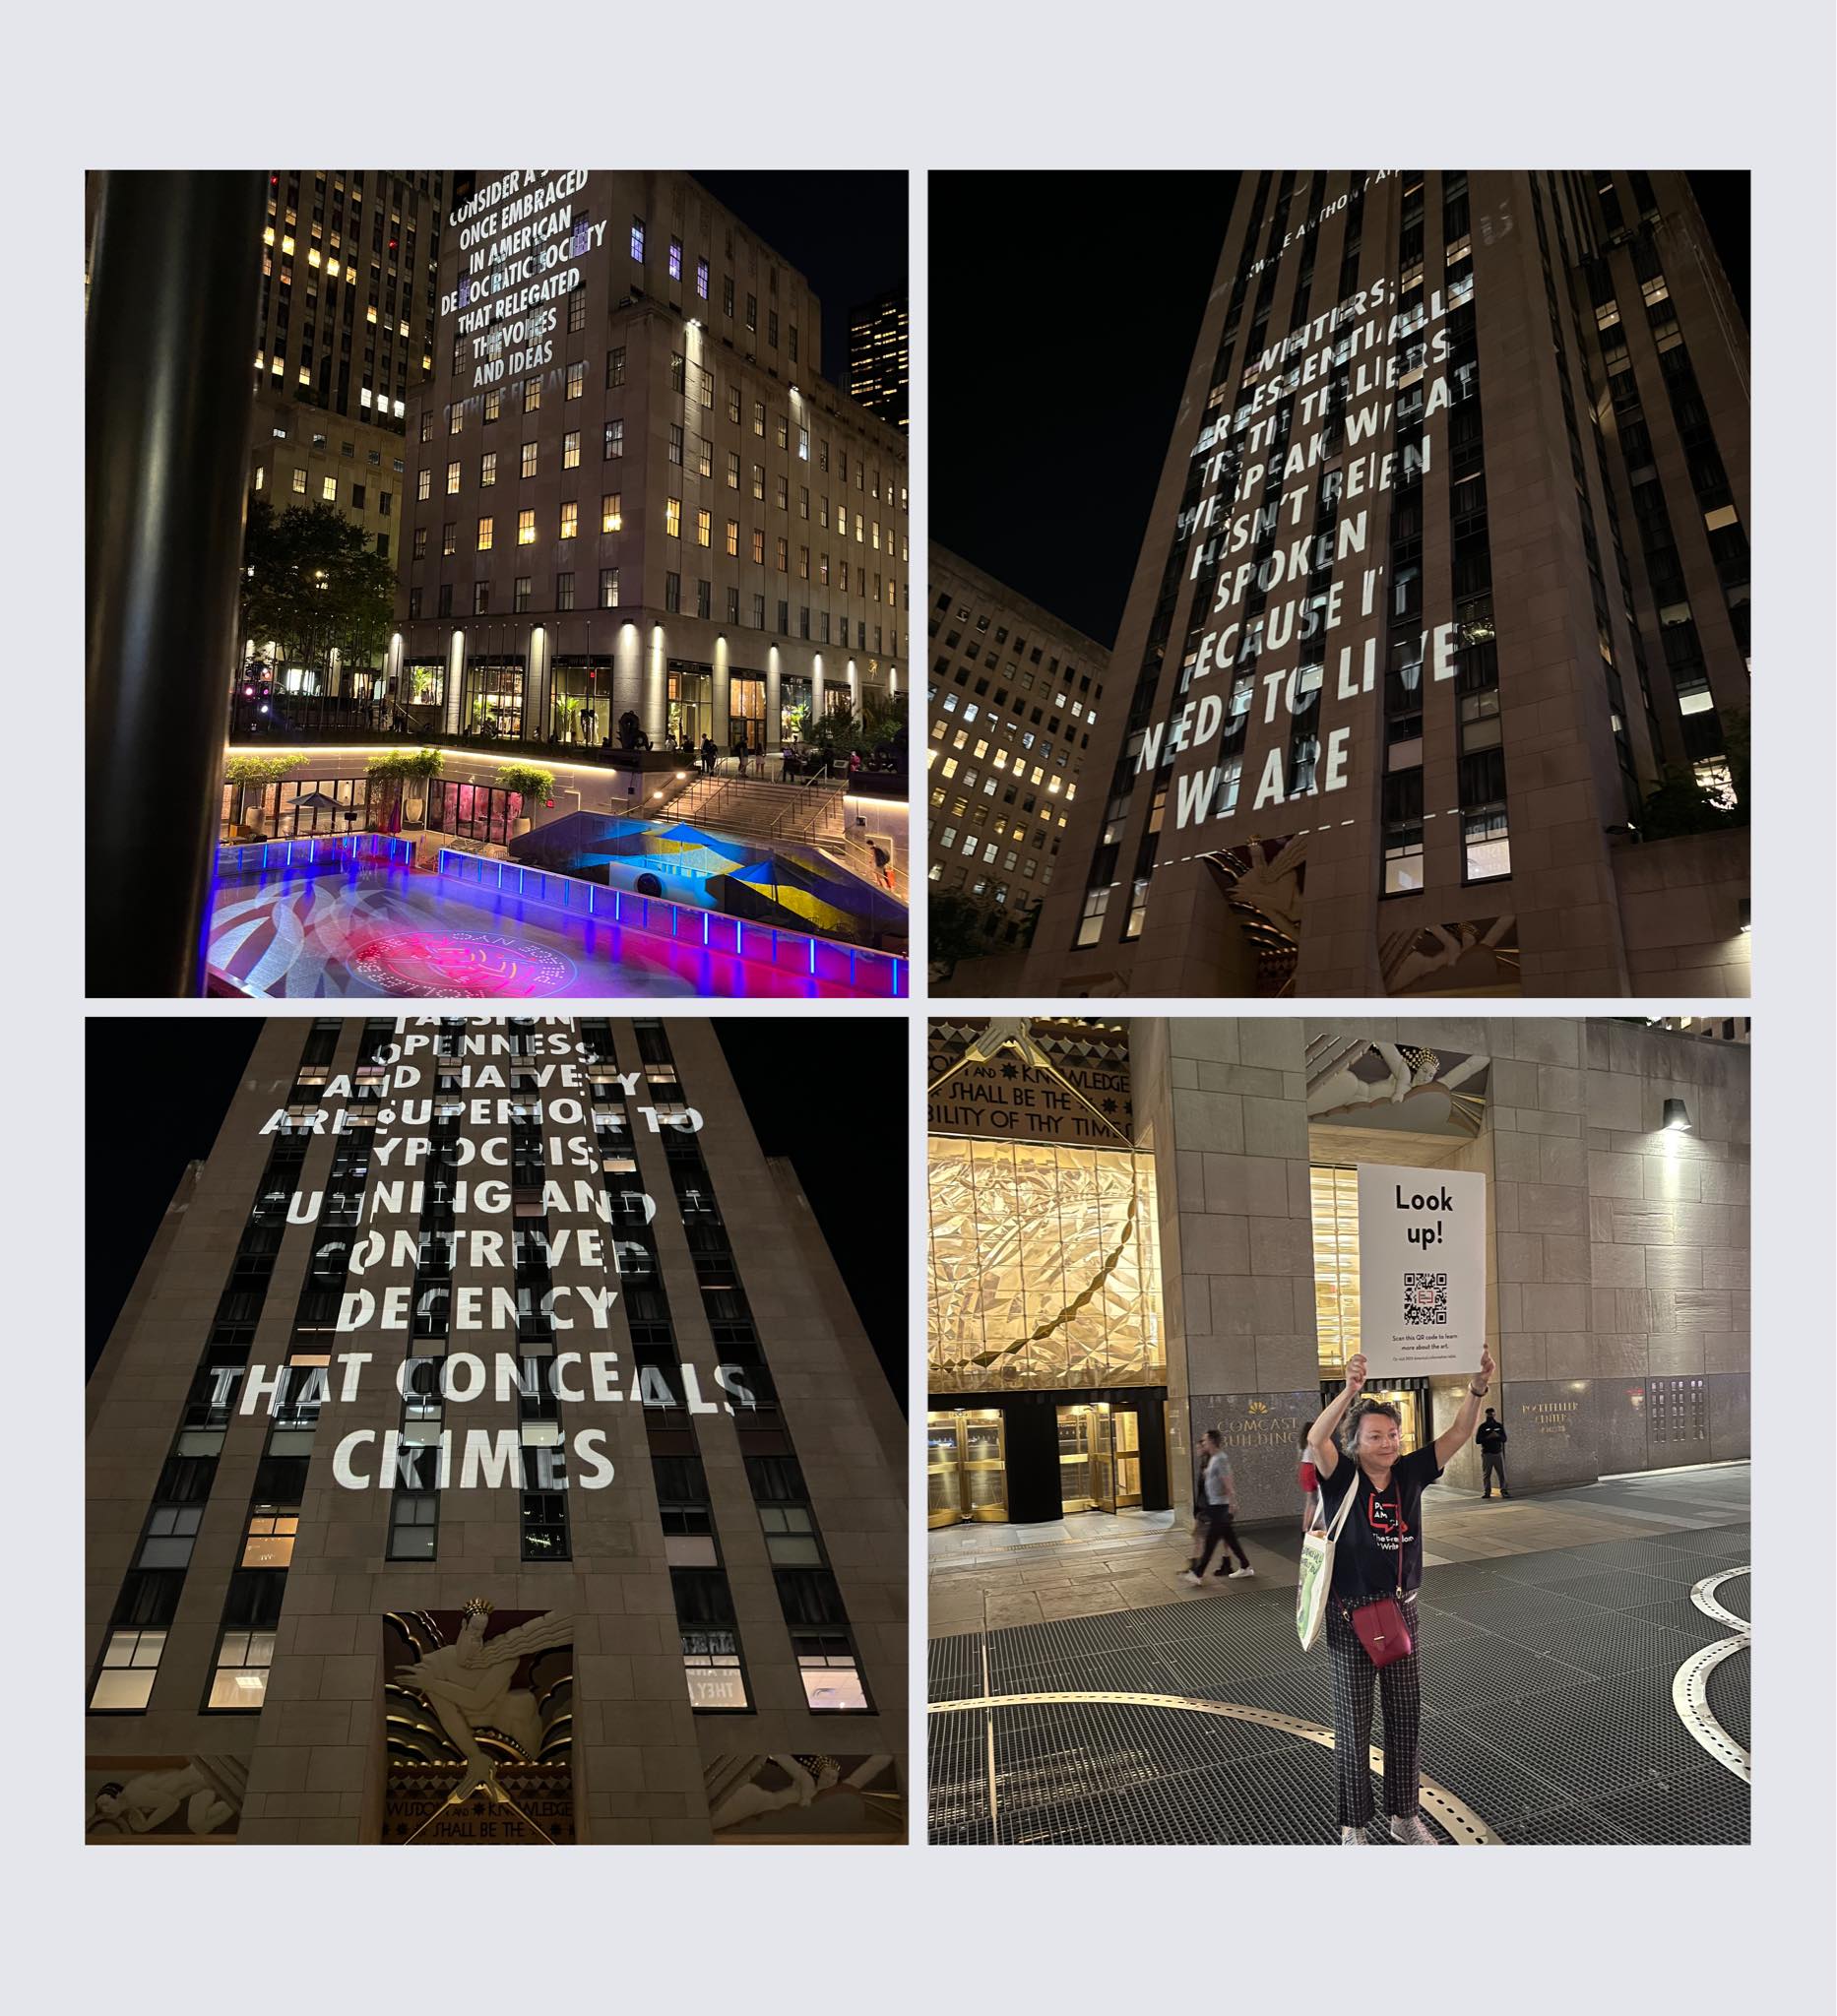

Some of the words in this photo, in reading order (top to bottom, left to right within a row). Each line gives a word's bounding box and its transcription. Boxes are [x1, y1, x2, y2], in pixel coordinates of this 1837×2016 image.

[460, 213, 497, 250] ONCE
[501, 170, 589, 229] EMBRACED
[470, 249, 484, 275] IN
[488, 205, 572, 267] AMERICAN
[441, 256, 535, 316] DEOCRATIC
[458, 304, 492, 335] THAT
[495, 268, 580, 321] RELEGATED
[473, 359, 504, 388] AND
[508, 340, 553, 375] IDEAS
[1213, 510, 1367, 613] SPOKEN
[1180, 580, 1343, 693] ECAUSE
[1252, 726, 1351, 811] ARE
[949, 1082, 1009, 1105] SHALL
[1014, 1087, 1035, 1107] BE
[1042, 1090, 1071, 1111] THE
[1023, 1068, 1131, 1094] KNWLEDGE
[990, 1109, 1021, 1130] OF
[1026, 1112, 1065, 1134] THY
[1396, 1184, 1453, 1212] Look
[1407, 1221, 1443, 1250] up!
[336, 1284, 618, 1333] DECENCY
[210, 1352, 373, 1416] THAT
[396, 1352, 756, 1417] CONCEALS
[1217, 1417, 1299, 1433] COMCAST
[332, 1428, 615, 1490] CRIMES
[388, 1801, 448, 1818] WISDO
[488, 1801, 573, 1818] KNWLEDGE
